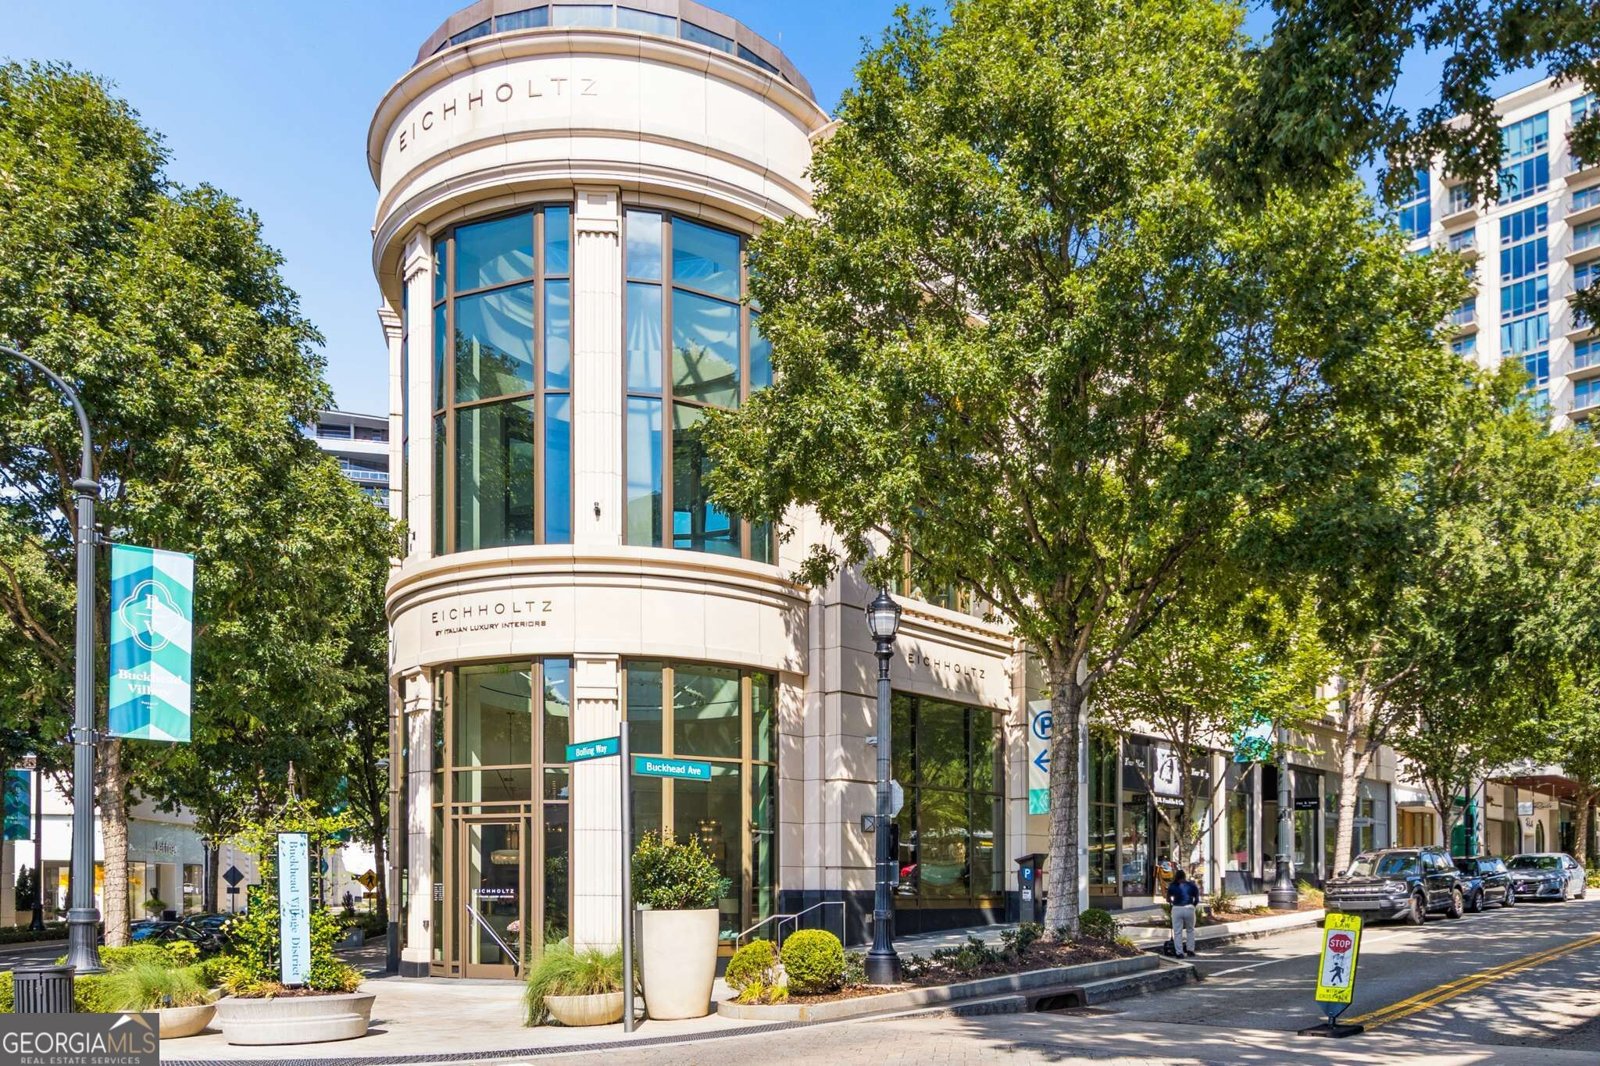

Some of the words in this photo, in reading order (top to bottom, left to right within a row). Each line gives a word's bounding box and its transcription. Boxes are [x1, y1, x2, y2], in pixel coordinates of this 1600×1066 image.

[400, 78, 598, 152] EICHHOLTZ
[432, 600, 552, 623] EICHHOLTZ
[444, 626, 468, 635] ITALIAN
[470, 622, 499, 631] LUXURY
[501, 620, 547, 628] INTERIORS
[908, 653, 985, 679] EICHHOLTZ
[118, 668, 182, 684] Buckd
[596, 744, 607, 754] Way
[646, 762, 685, 773] Buckhead
[688, 766, 701, 775] Ave
[289, 841, 299, 893] Buckhead
[1024, 868, 1031, 879] P
[290, 896, 300, 935] Village
[1329, 914, 1355, 923] STTE
[1329, 939, 1351, 948] STOP
[291, 937, 301, 976] District
